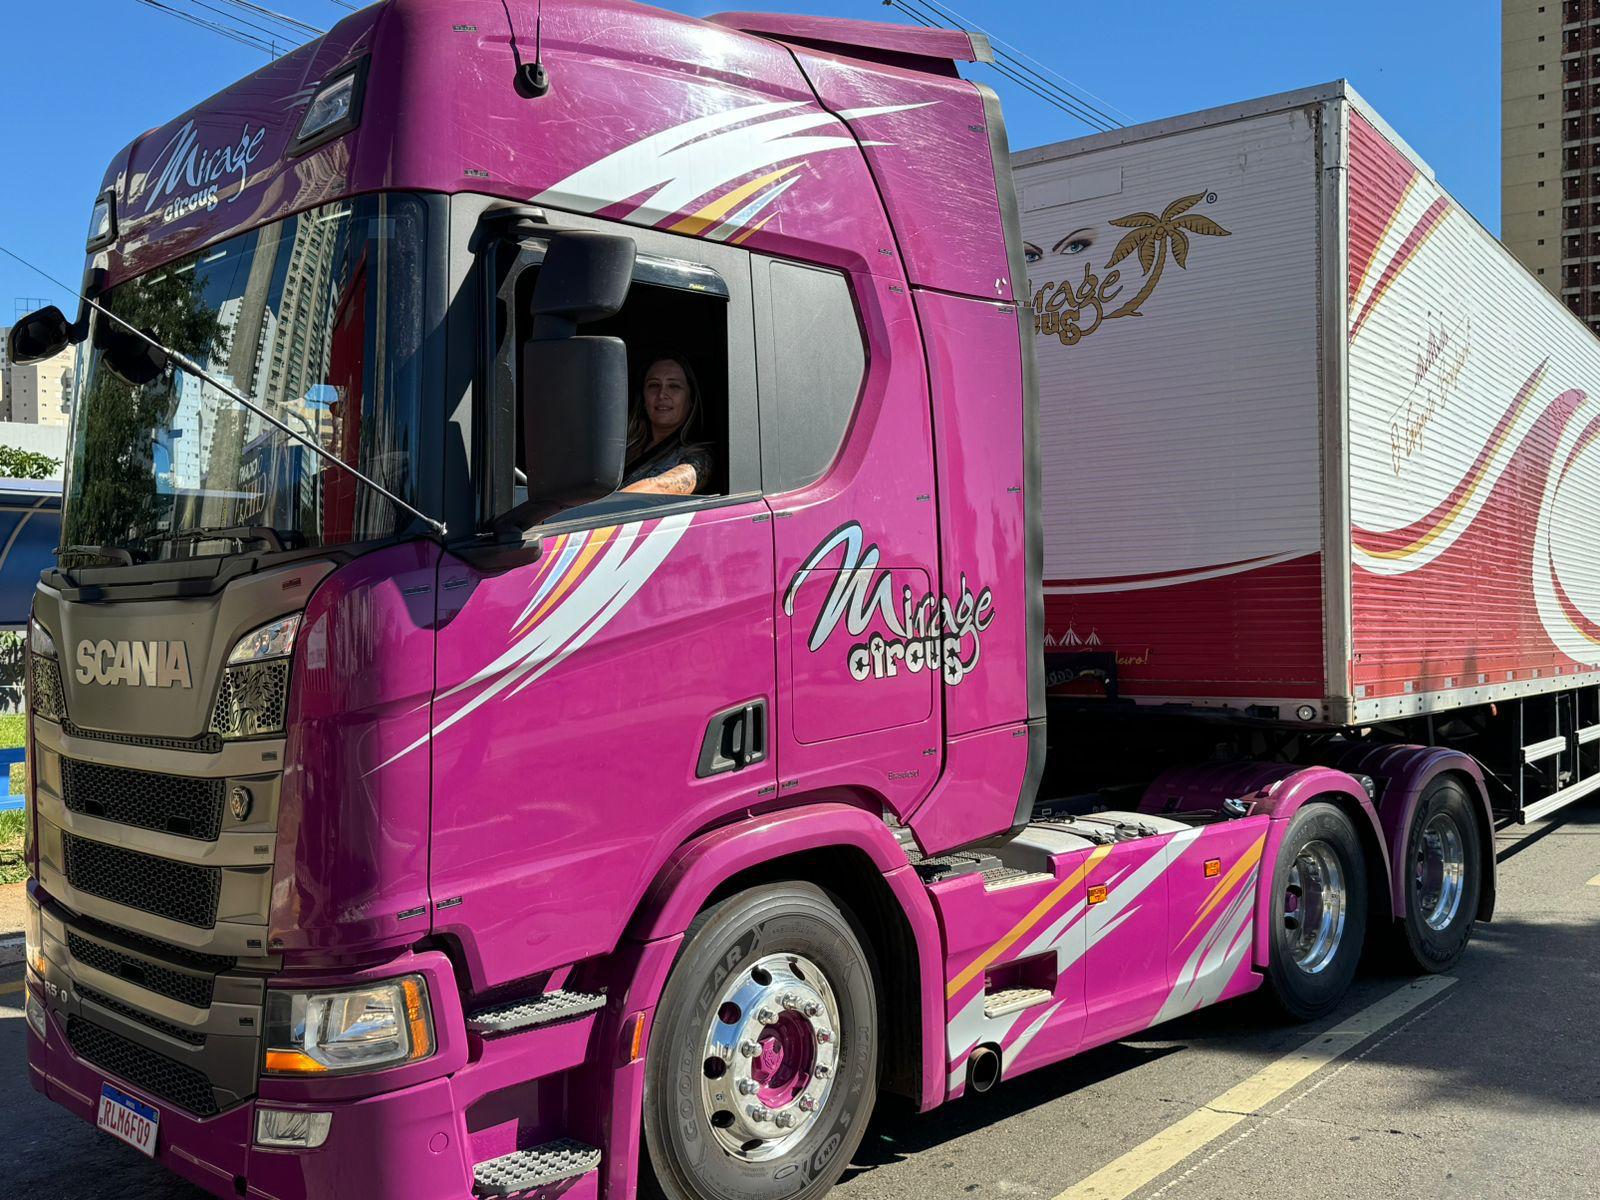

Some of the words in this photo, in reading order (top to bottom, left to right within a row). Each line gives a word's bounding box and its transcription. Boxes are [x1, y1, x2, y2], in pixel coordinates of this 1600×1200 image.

[141, 119, 265, 213] Mirage
[163, 184, 218, 222] circus
[1029, 262, 1123, 336] rage
[782, 520, 995, 674] Mirage
[76, 639, 192, 689] SCANIA
[847, 631, 963, 686] circus
[104, 1099, 151, 1147] RLM6F09
